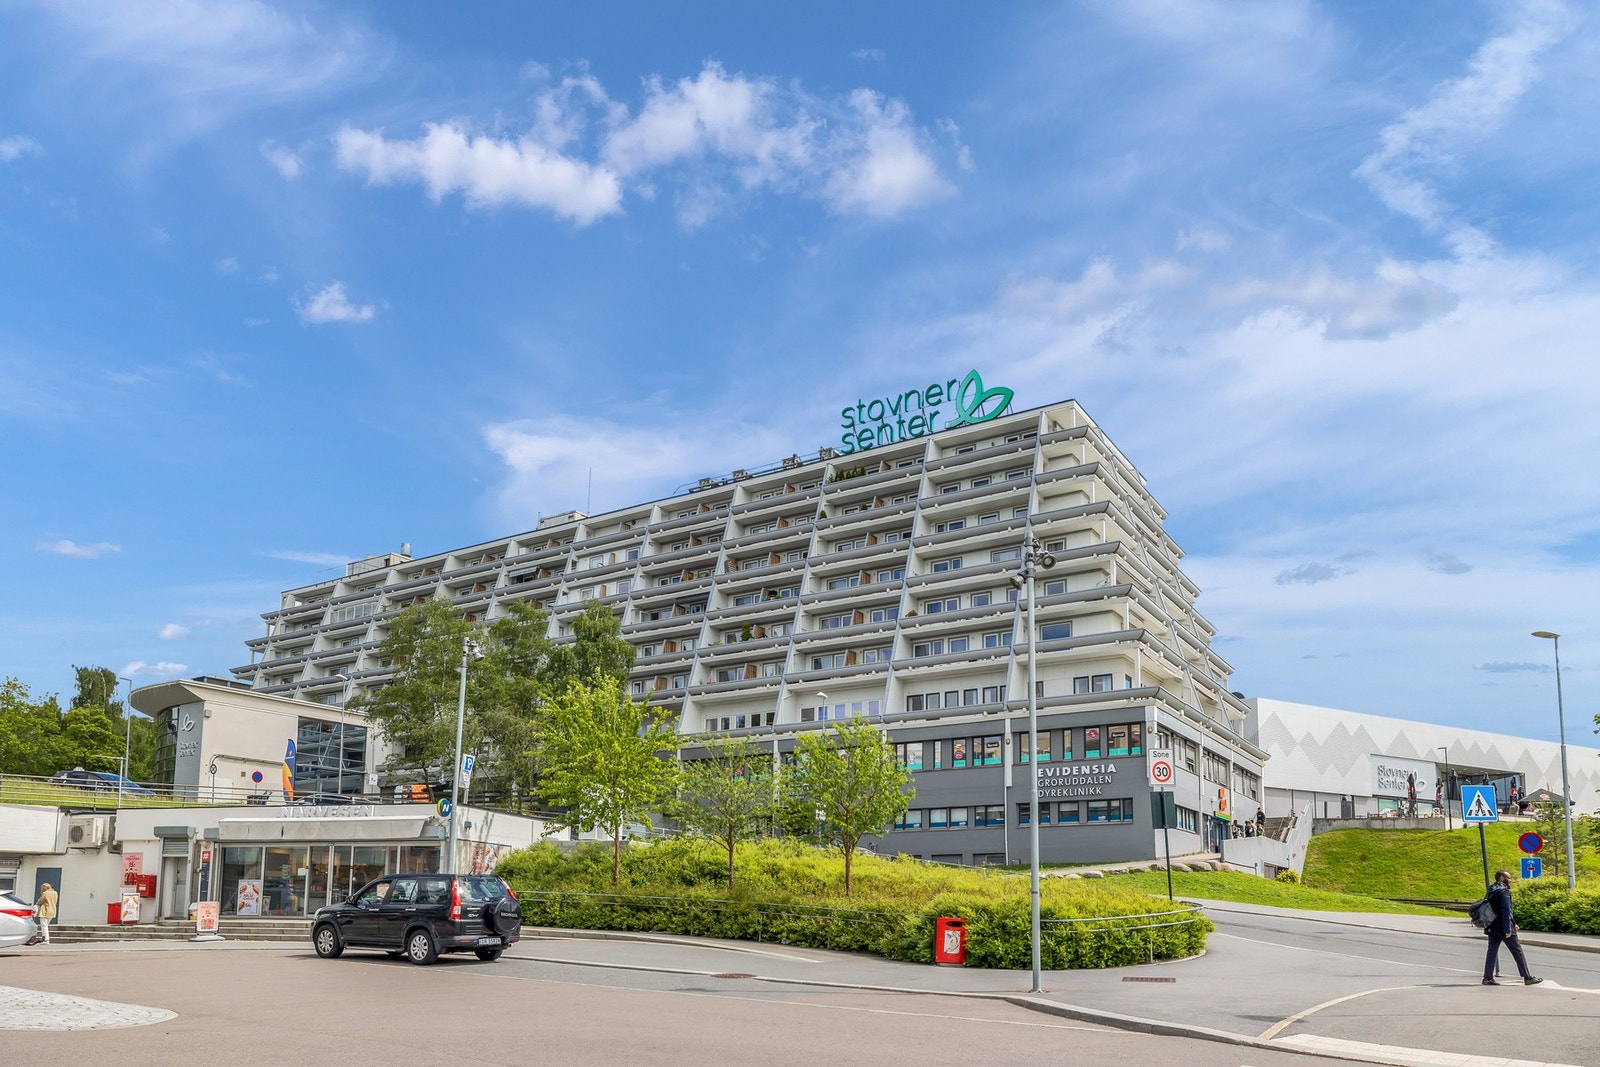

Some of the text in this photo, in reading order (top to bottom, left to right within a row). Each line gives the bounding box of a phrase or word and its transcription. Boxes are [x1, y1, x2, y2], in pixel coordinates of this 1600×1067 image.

[841, 378, 957, 428] stovner
[841, 410, 940, 455] senter
[1152, 751, 1170, 759] Sone
[1037, 763, 1117, 778] EVIDENSIA
[1156, 766, 1169, 777] 30
[1037, 775, 1113, 788] GRORUDDALEN
[1037, 786, 1103, 798] DYREKLINIKK
[280, 805, 376, 818] NARVESEN
